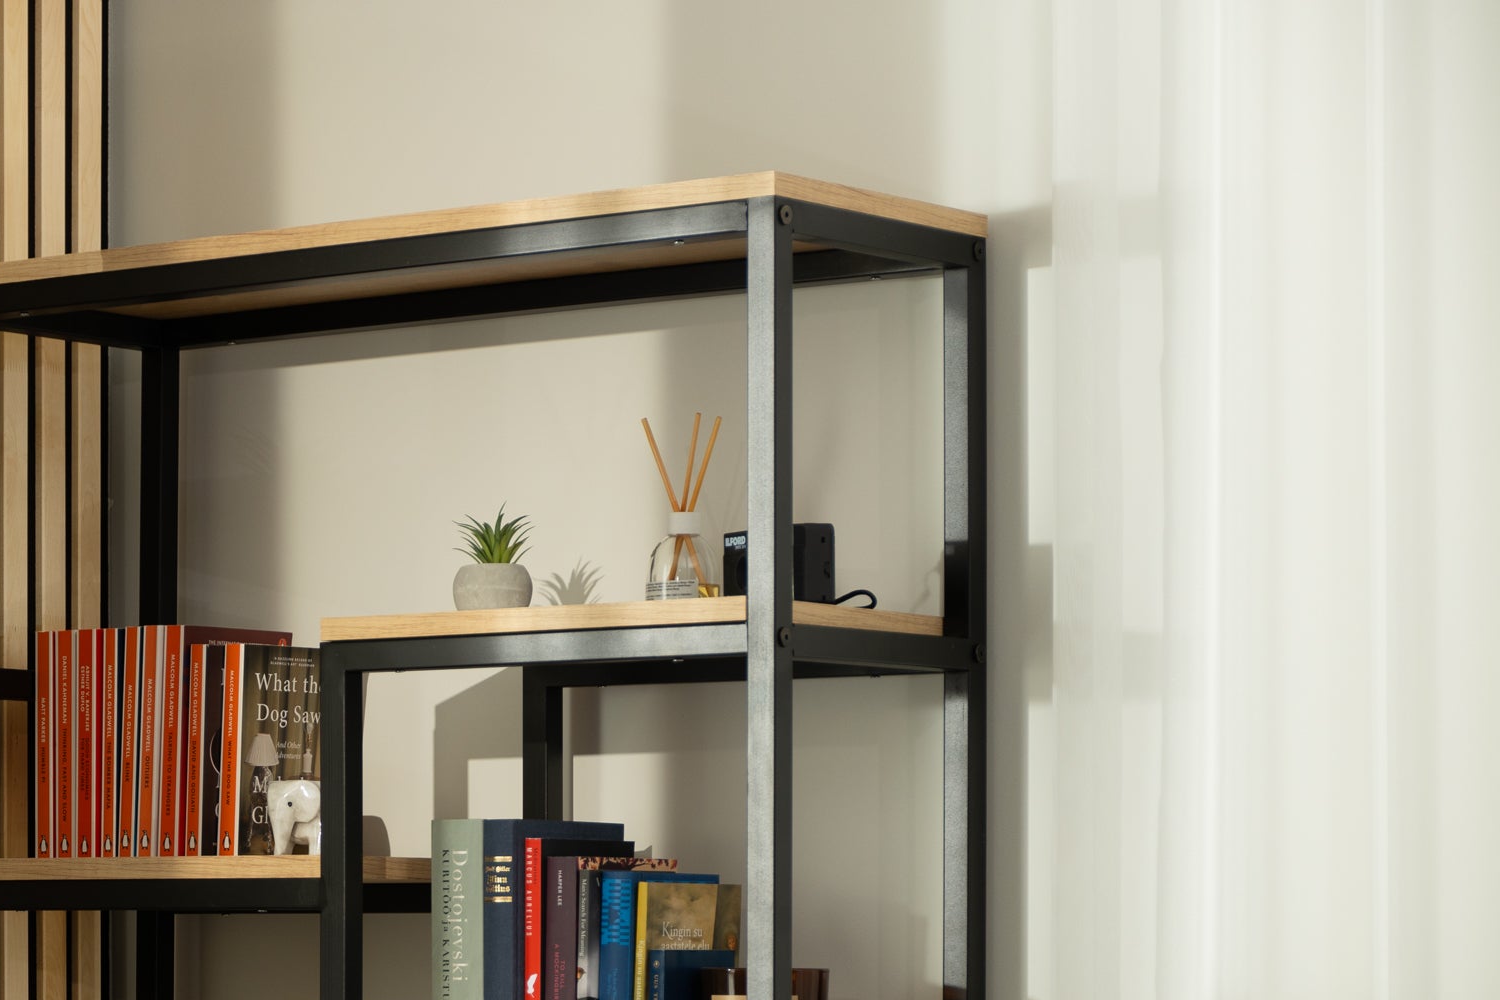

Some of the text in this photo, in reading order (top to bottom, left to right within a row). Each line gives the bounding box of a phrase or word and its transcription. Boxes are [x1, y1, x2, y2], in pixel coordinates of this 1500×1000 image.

[725, 536, 746, 546] ILFORD
[255, 672, 320, 694] What th
[257, 703, 320, 728] Dog Saw
[446, 849, 468, 982] Dostojevski
[441, 920, 451, 932] ja
[662, 921, 703, 941] Kingin su
[560, 960, 565, 971] TO
